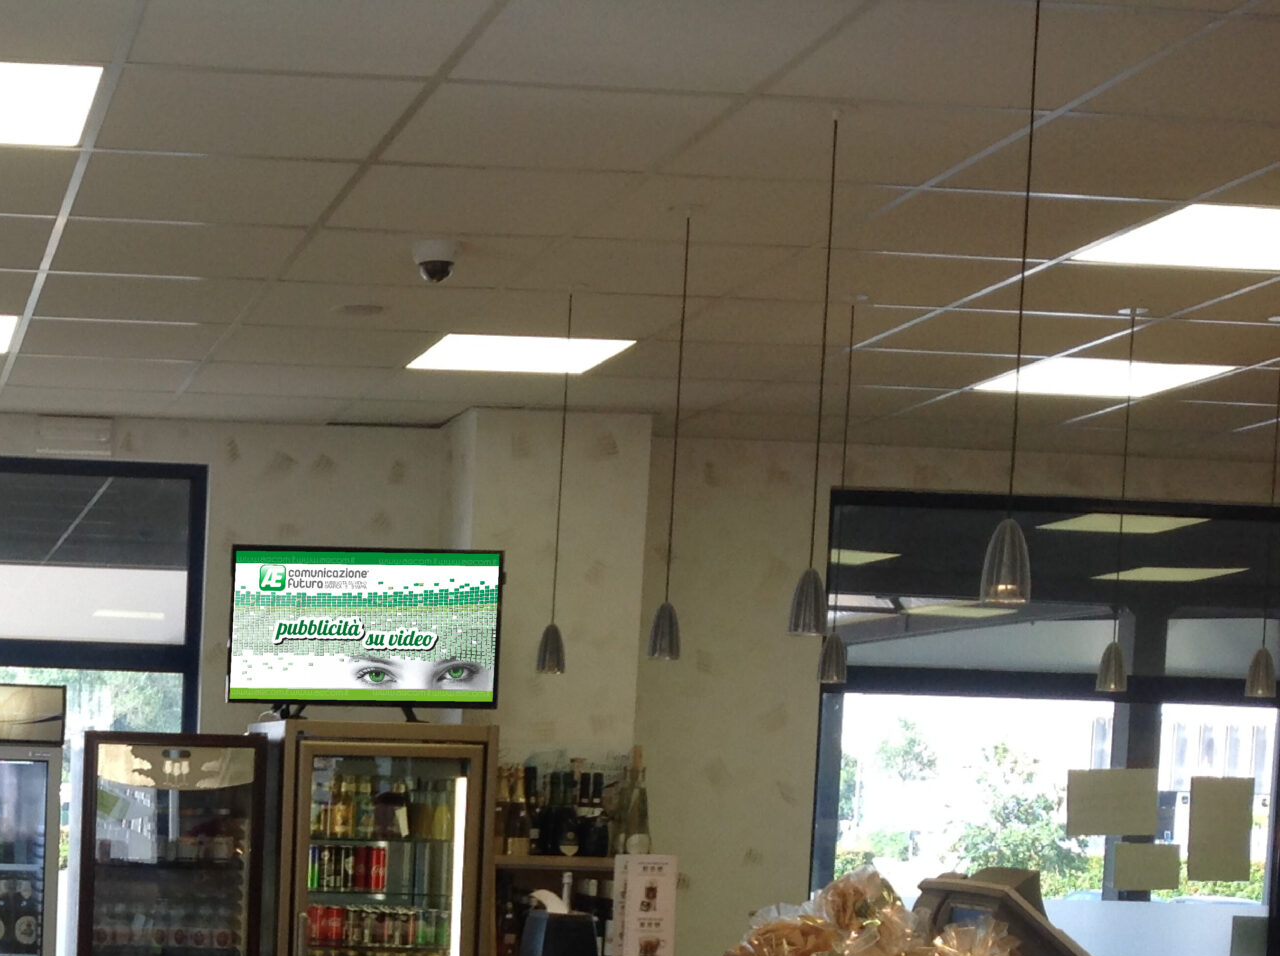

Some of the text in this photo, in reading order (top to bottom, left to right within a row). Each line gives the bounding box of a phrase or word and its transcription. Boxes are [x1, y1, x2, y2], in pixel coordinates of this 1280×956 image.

[288, 567, 368, 579] comunicazione
[287, 578, 324, 589] futura
[275, 619, 434, 647] pubblicità su video
